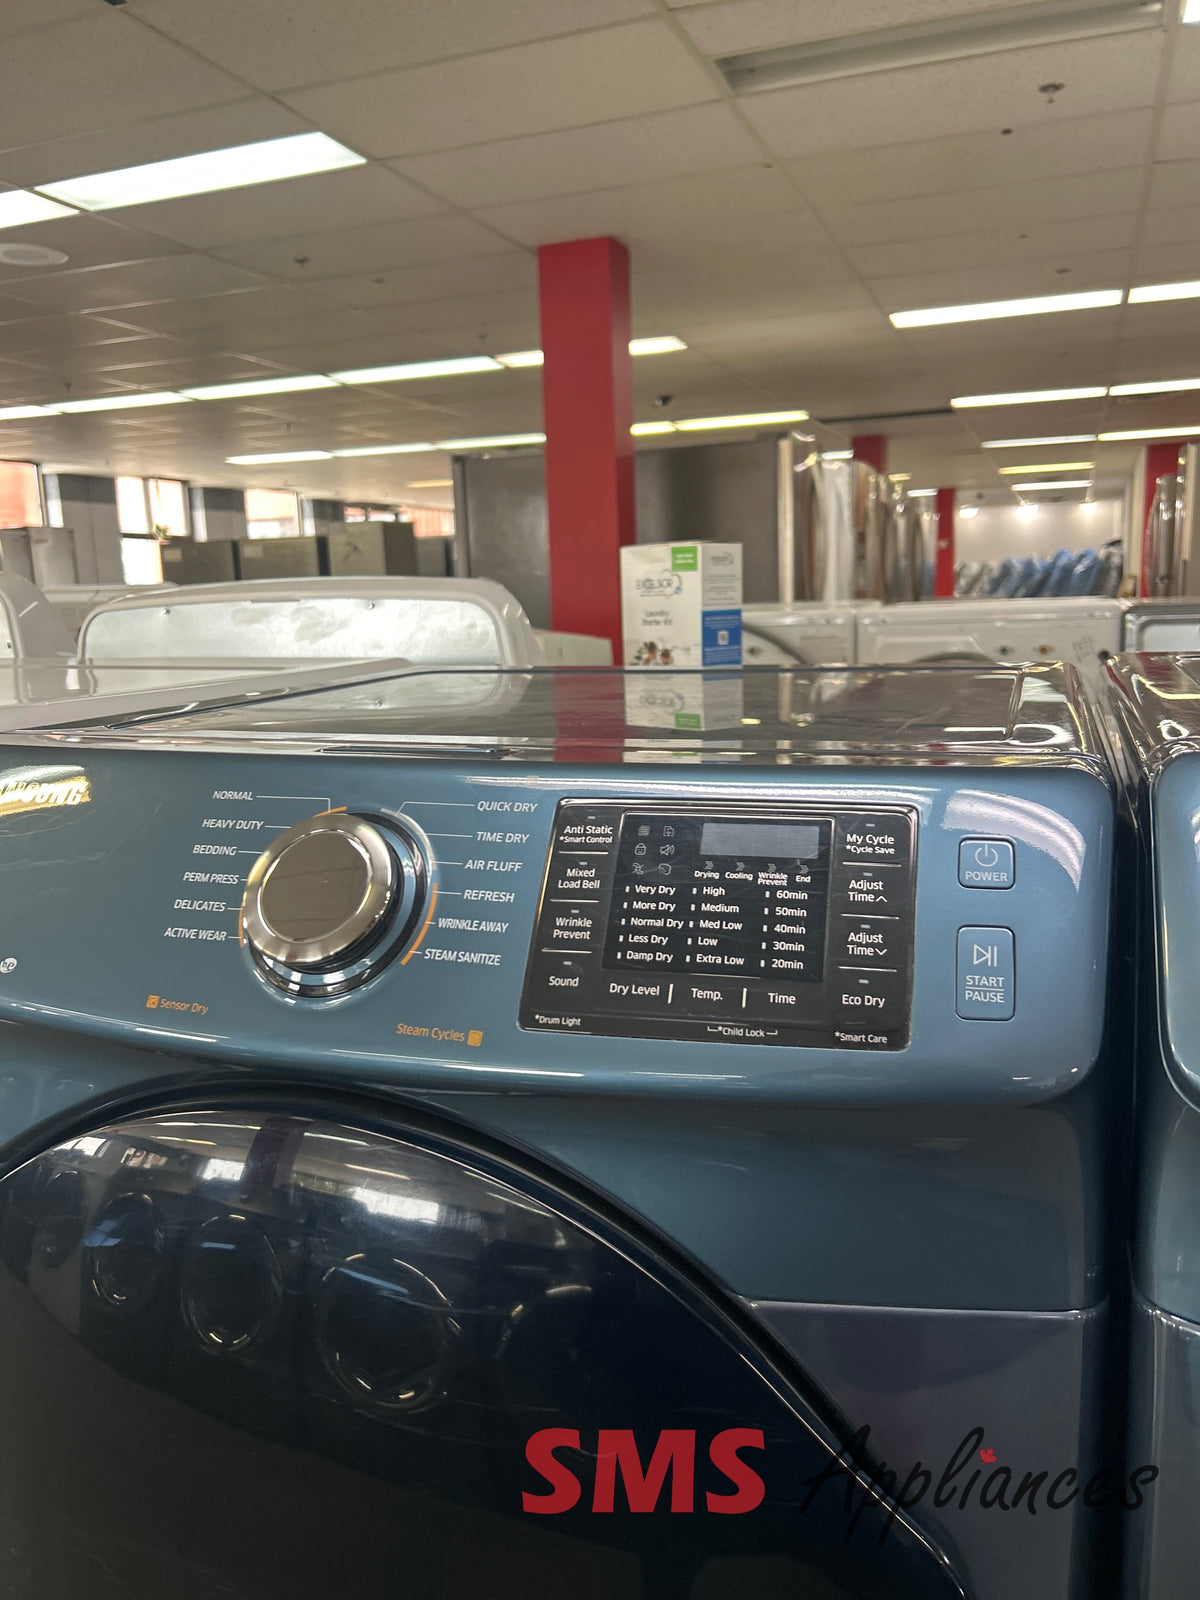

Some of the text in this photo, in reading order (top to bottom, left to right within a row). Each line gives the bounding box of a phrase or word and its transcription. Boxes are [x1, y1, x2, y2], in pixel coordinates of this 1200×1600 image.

[212, 790, 253, 800] NORMAL
[477, 801, 538, 813] QUICK DRY
[202, 819, 264, 831] HEAVY DUTY
[564, 825, 613, 835] Anti Static
[476, 832, 530, 844] TIME DRY
[586, 836, 613, 844] Control
[846, 833, 895, 846] My Cycle
[192, 845, 237, 856] BEDDING
[874, 846, 895, 855] Save
[464, 860, 523, 872] AIR FLUFF
[183, 871, 239, 884] PERM PRESS
[566, 868, 595, 878] Mixed
[694, 870, 720, 880] Drying
[725, 871, 753, 881] Cooling
[758, 872, 788, 880] Wrinkle
[965, 870, 1008, 882] POWER
[558, 880, 601, 889] Load Bell
[757, 879, 788, 887] Prevent
[795, 875, 811, 883] End
[635, 885, 676, 896] Very Dry
[848, 879, 884, 892] Adjust
[463, 890, 515, 903] REFRESH
[703, 886, 725, 897] High
[776, 890, 808, 900] 60min
[848, 891, 875, 902] Time
[174, 899, 226, 912] DELICATES
[632, 901, 676, 912] More Dry
[701, 903, 739, 913] Medium
[775, 906, 807, 917] 50min
[438, 918, 509, 933] WRINKLE AWAY
[555, 917, 593, 928] Wrinkle
[630, 917, 684, 929] Normal Dry
[699, 919, 743, 930] Med Low
[164, 927, 227, 941] ACTIVE WEAR
[553, 929, 591, 940] Prevent
[774, 924, 806, 934] 40min
[628, 934, 669, 946] Less Dry
[697, 936, 718, 946] Low
[848, 932, 883, 944] Adjust
[772, 941, 805, 952] 30min
[847, 944, 875, 956] Time
[423, 948, 502, 966] STEAM SANITIZE
[626, 951, 674, 963] Damp Dry
[696, 953, 745, 965] Extra Low
[771, 958, 804, 970] 20min
[548, 976, 580, 987] Sound
[965, 975, 1005, 987] START
[609, 983, 660, 996] Dry Level
[691, 988, 723, 1001] Temp.
[767, 992, 796, 1004] Time
[841, 994, 886, 1008] Eco Dry
[965, 990, 1005, 1003] PAUSE
[160, 998, 209, 1015] Sensor Dry
[561, 1016, 581, 1026] Light
[396, 1022, 465, 1042] Steam Cycles
[745, 1028, 765, 1038] Lock
[867, 1034, 888, 1044] Care
